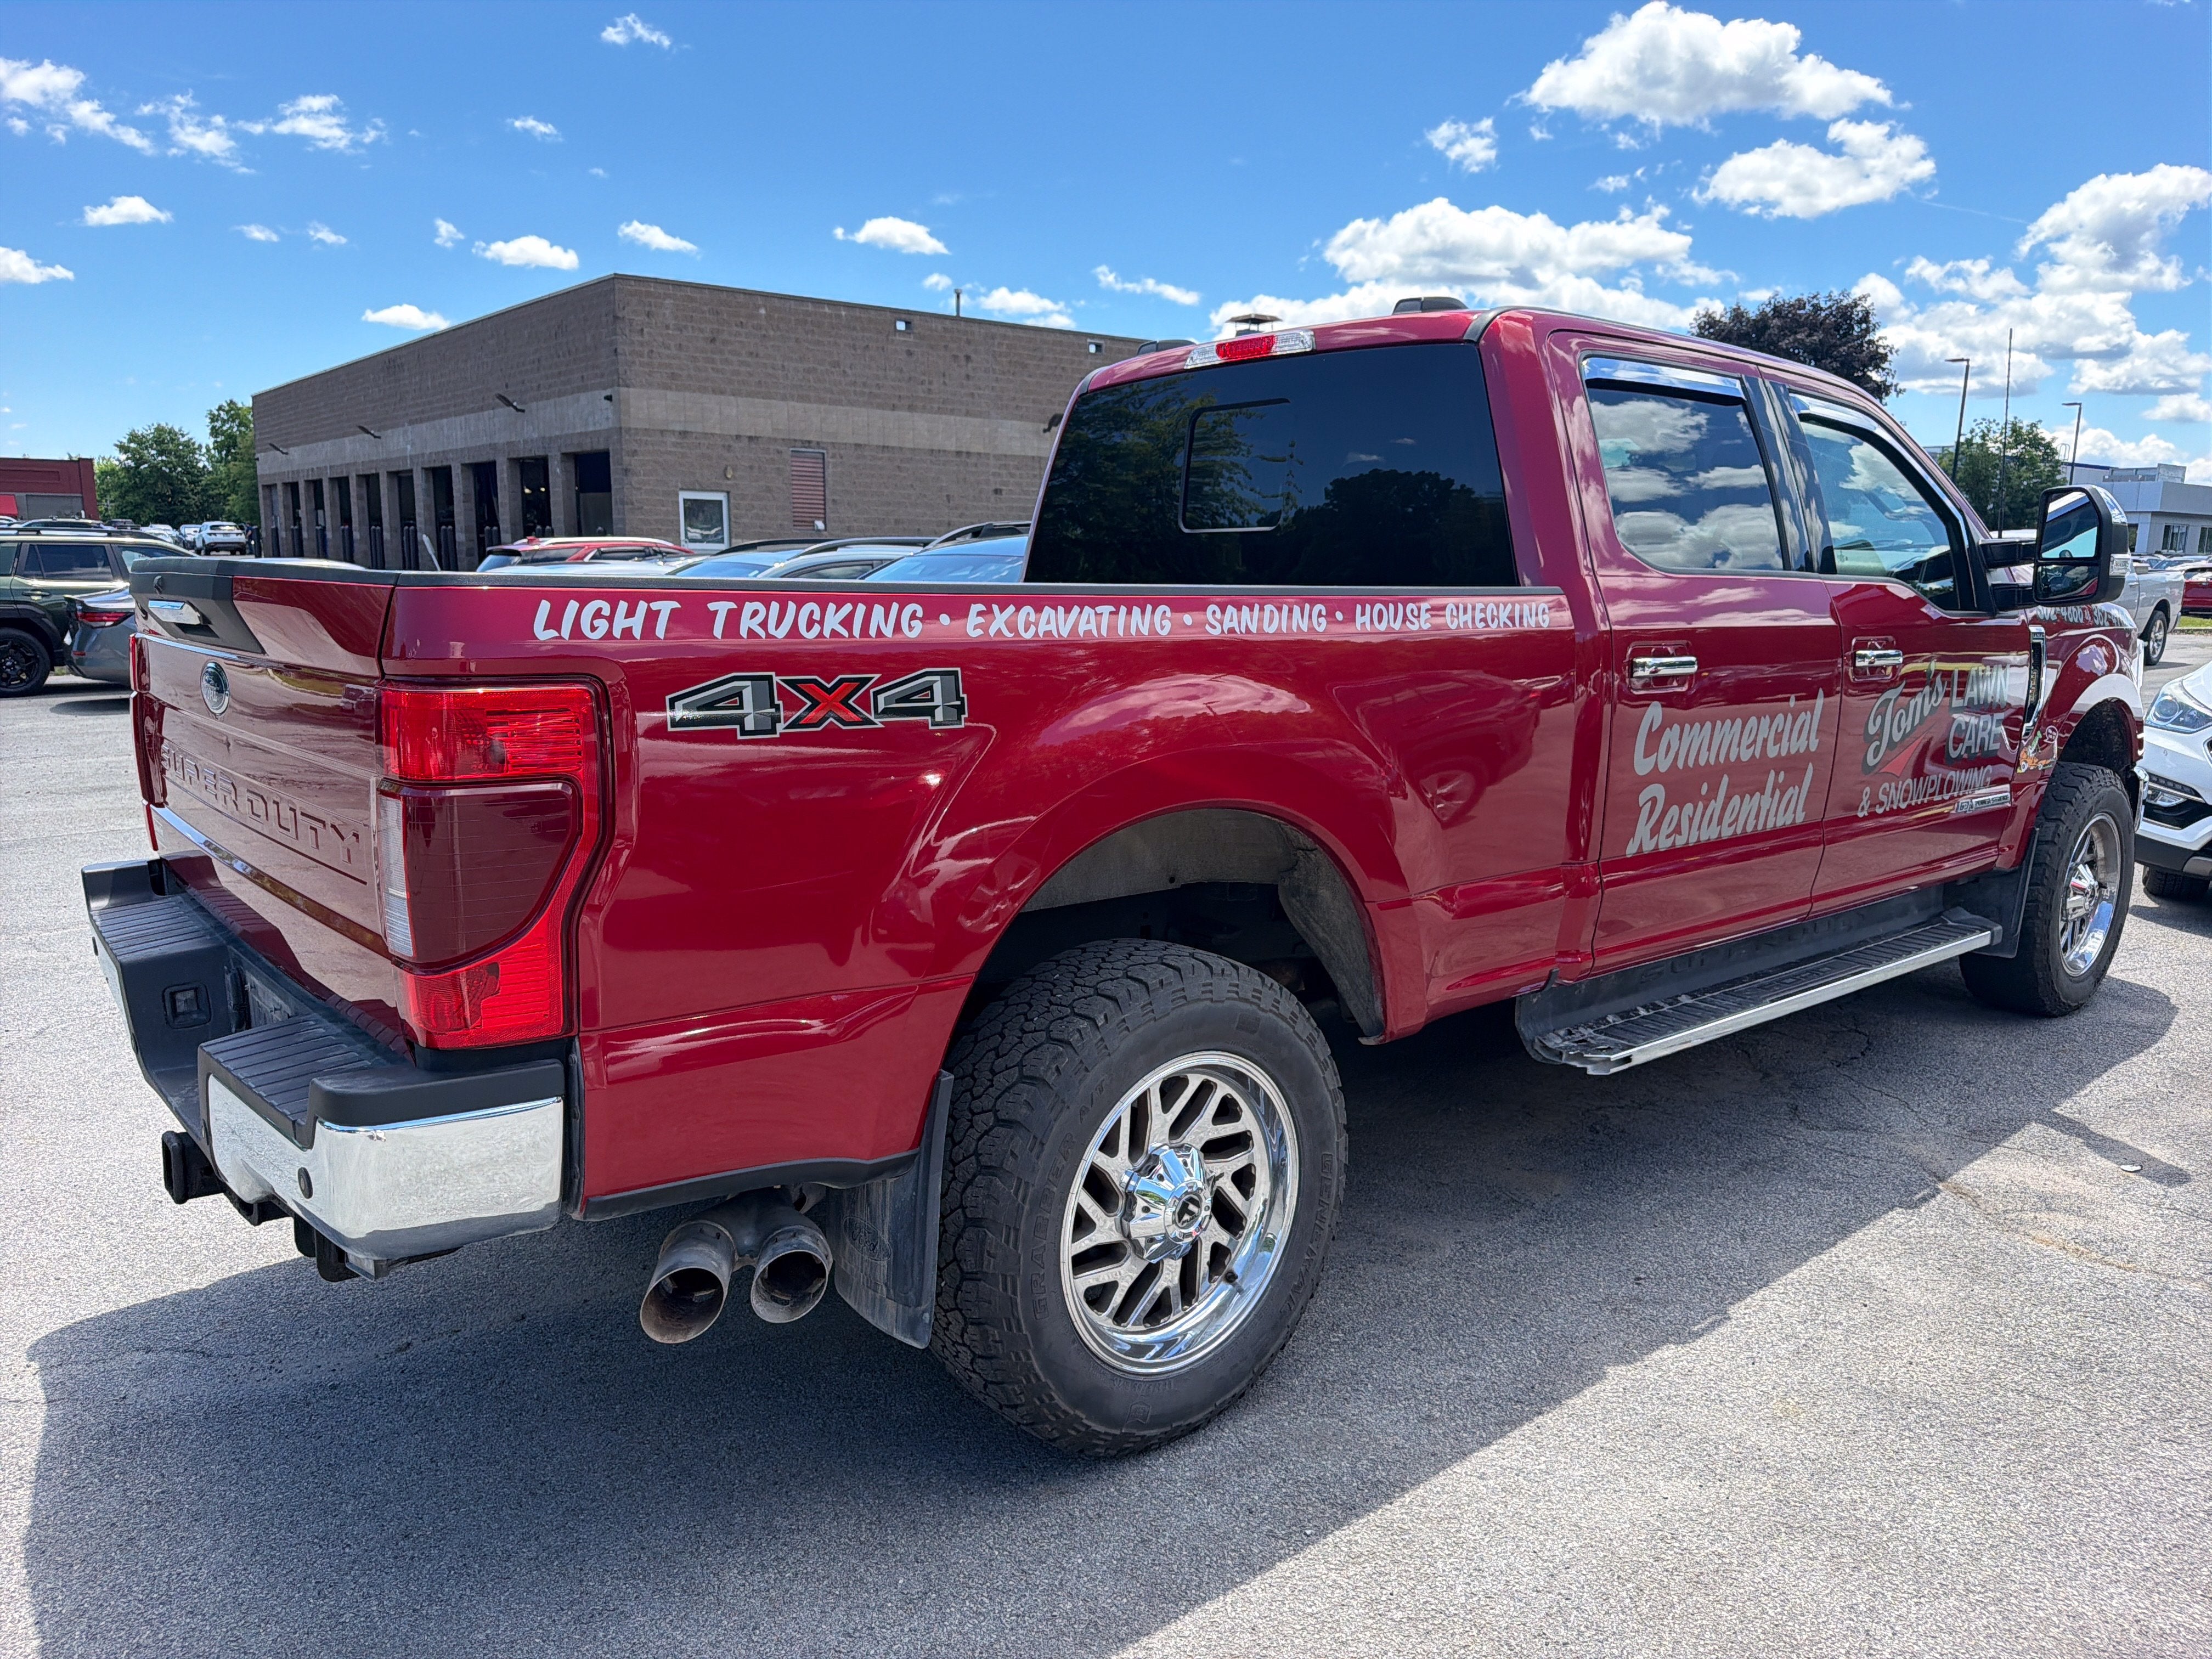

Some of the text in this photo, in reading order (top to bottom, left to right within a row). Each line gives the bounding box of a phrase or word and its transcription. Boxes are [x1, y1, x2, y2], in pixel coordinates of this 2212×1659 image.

[533, 600, 1550, 641] LIGHT TRUCKING EXCAVATING SANDING HOUSE CHECKING
[1866, 658, 1948, 767] Tom's
[1951, 664, 2010, 708] LAWN
[1633, 687, 1825, 776] Commercial
[1948, 713, 2005, 759] CARE
[161, 744, 360, 865] SUPER DUTY
[1626, 762, 1814, 858] Residential
[1857, 765, 1993, 817] & SNOWPLOWING
[1030, 1077, 1106, 1321] GRABBER A/T
